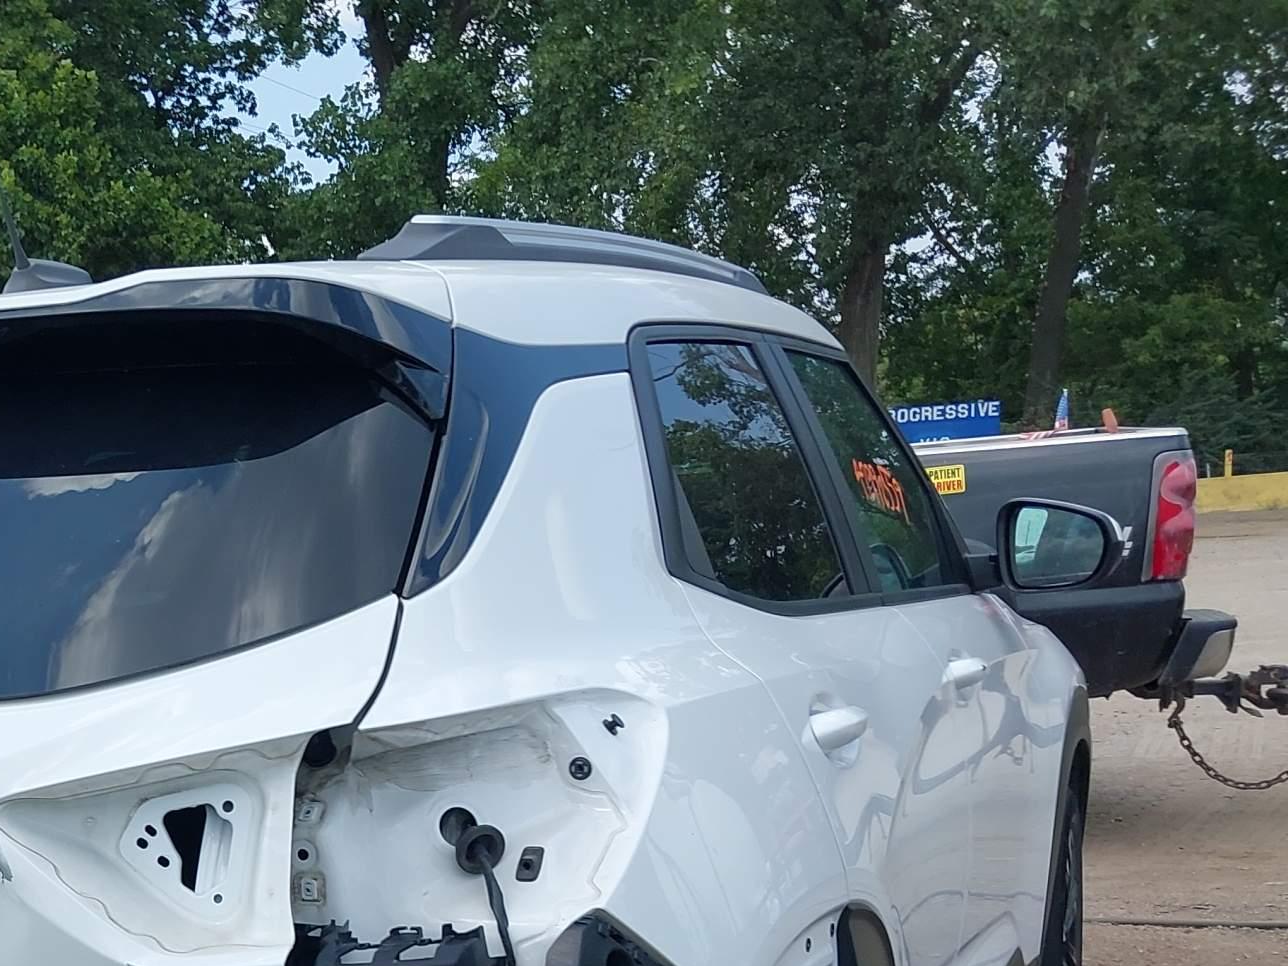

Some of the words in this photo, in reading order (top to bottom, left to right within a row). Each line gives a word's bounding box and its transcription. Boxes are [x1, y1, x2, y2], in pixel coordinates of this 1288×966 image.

[888, 401, 1000, 423] ROGRESSIVE
[928, 468, 960, 480] PATIENT
[936, 480, 963, 491] RIVER
